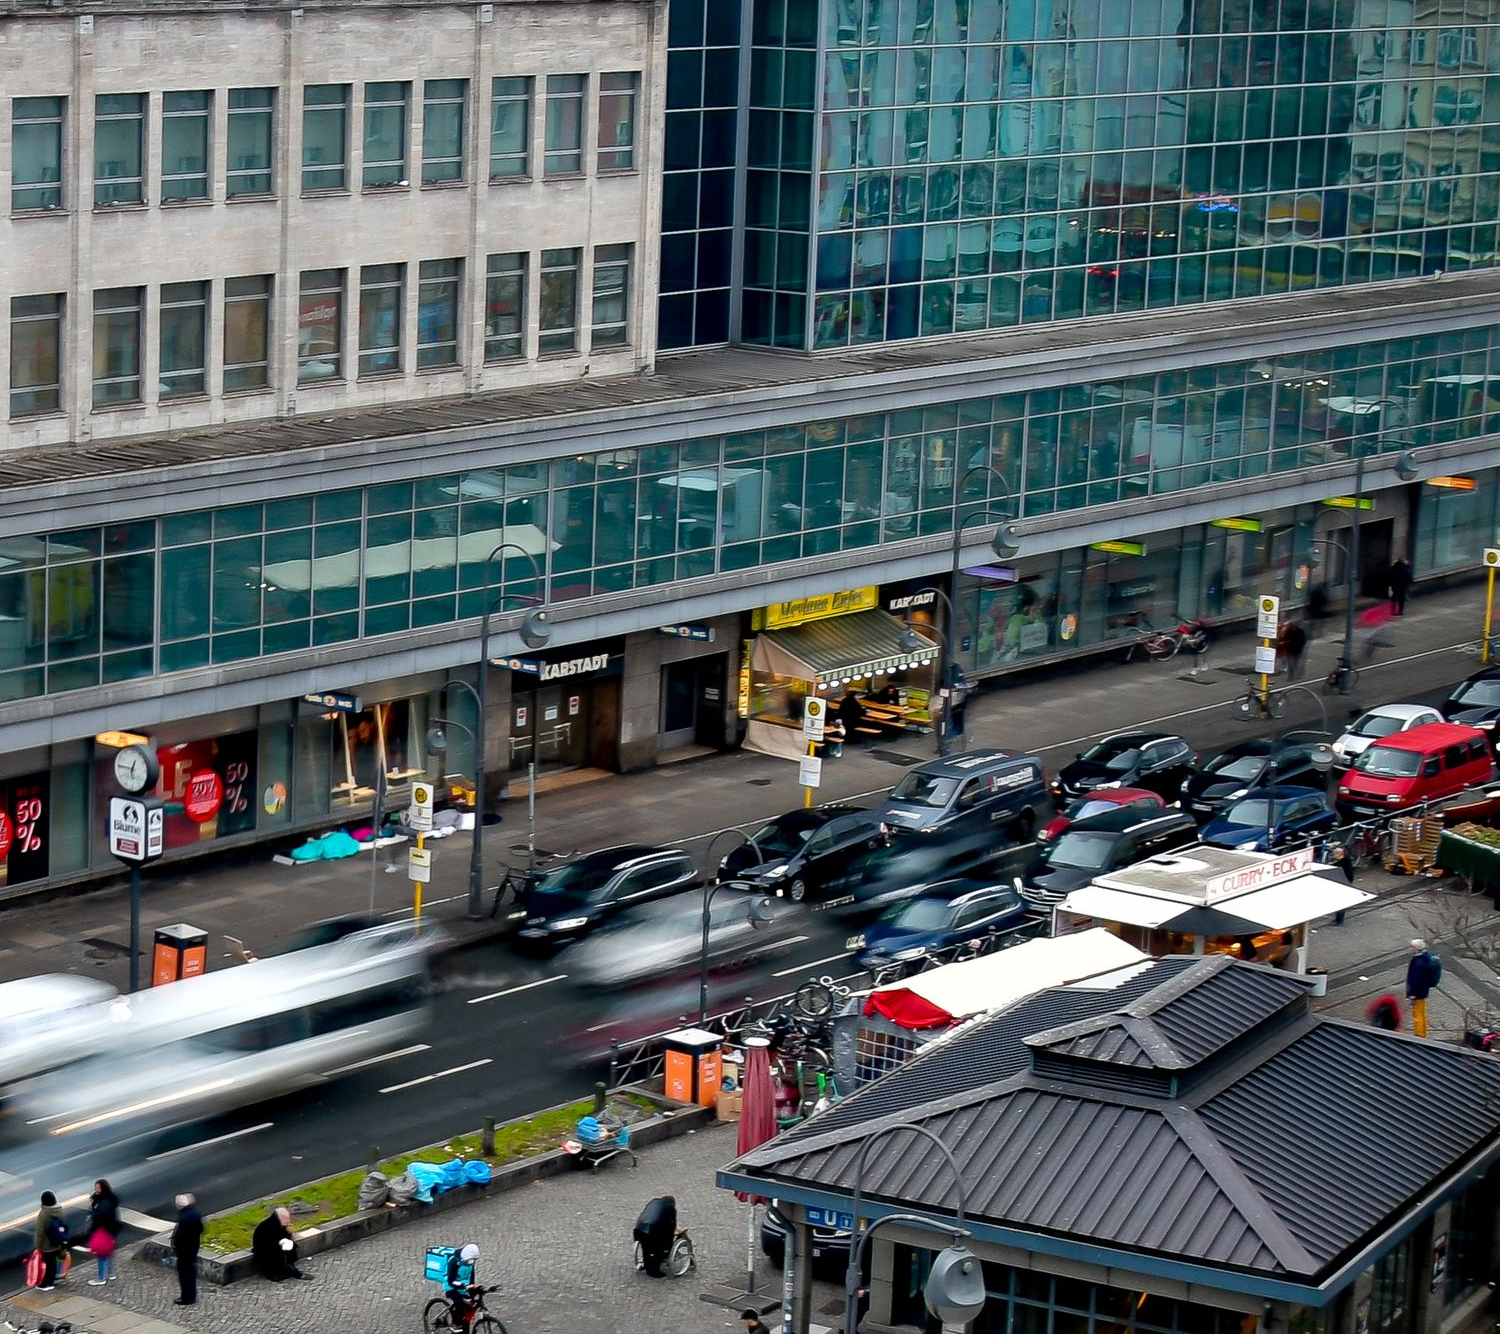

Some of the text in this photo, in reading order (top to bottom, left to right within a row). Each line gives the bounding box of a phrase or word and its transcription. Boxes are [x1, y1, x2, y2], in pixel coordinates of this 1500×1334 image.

[540, 653, 610, 681] KARSTADT
[226, 762, 249, 784] 50
[16, 798, 42, 823] 50
[225, 786, 248, 814] %
[15, 822, 42, 853] %
[113, 819, 141, 835] Blume
[824, 1210, 837, 1226] U
